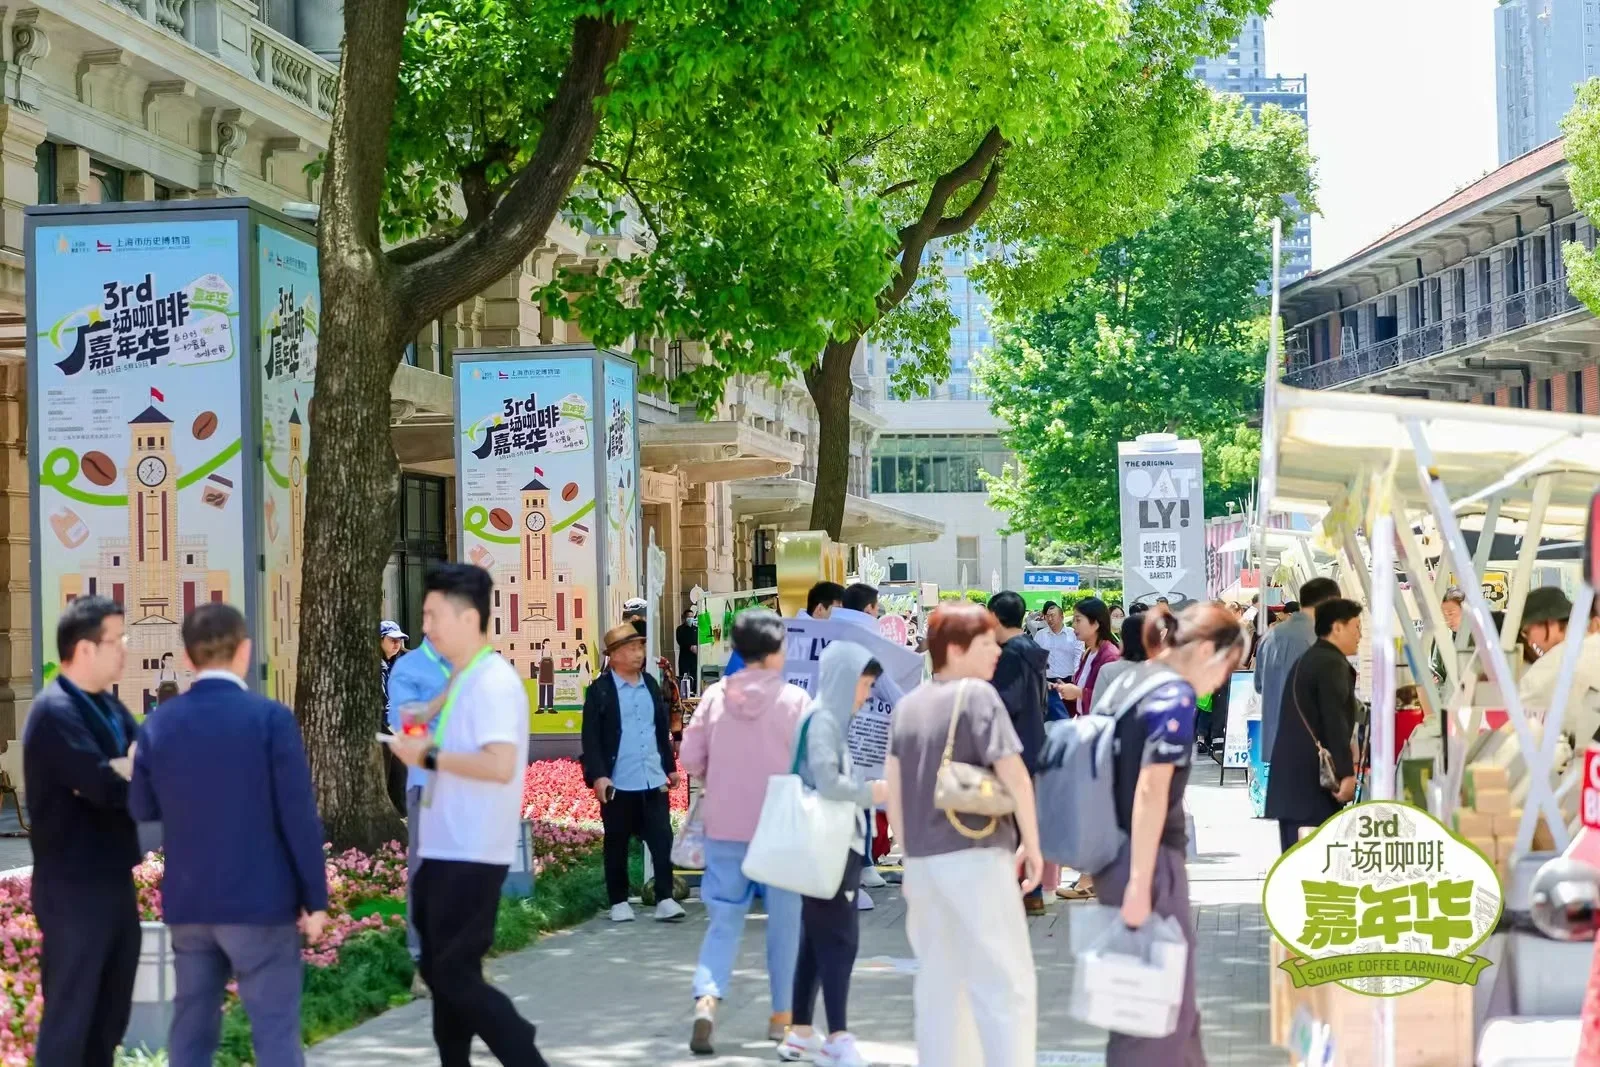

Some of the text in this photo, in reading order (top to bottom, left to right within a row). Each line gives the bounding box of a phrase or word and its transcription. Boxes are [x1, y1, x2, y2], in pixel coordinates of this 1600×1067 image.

[116, 235, 191, 248] 上海市历史博物馆
[103, 274, 152, 310] 3rd
[88, 328, 170, 372] 嘉年华
[503, 393, 536, 417] 3rd
[494, 429, 548, 457] 嘉年华
[1139, 500, 1190, 529] LY!
[1143, 540, 1176, 553] 咖啡大师
[1144, 555, 1176, 568] 燕麦奶
[1149, 571, 1172, 579] BARISTA
